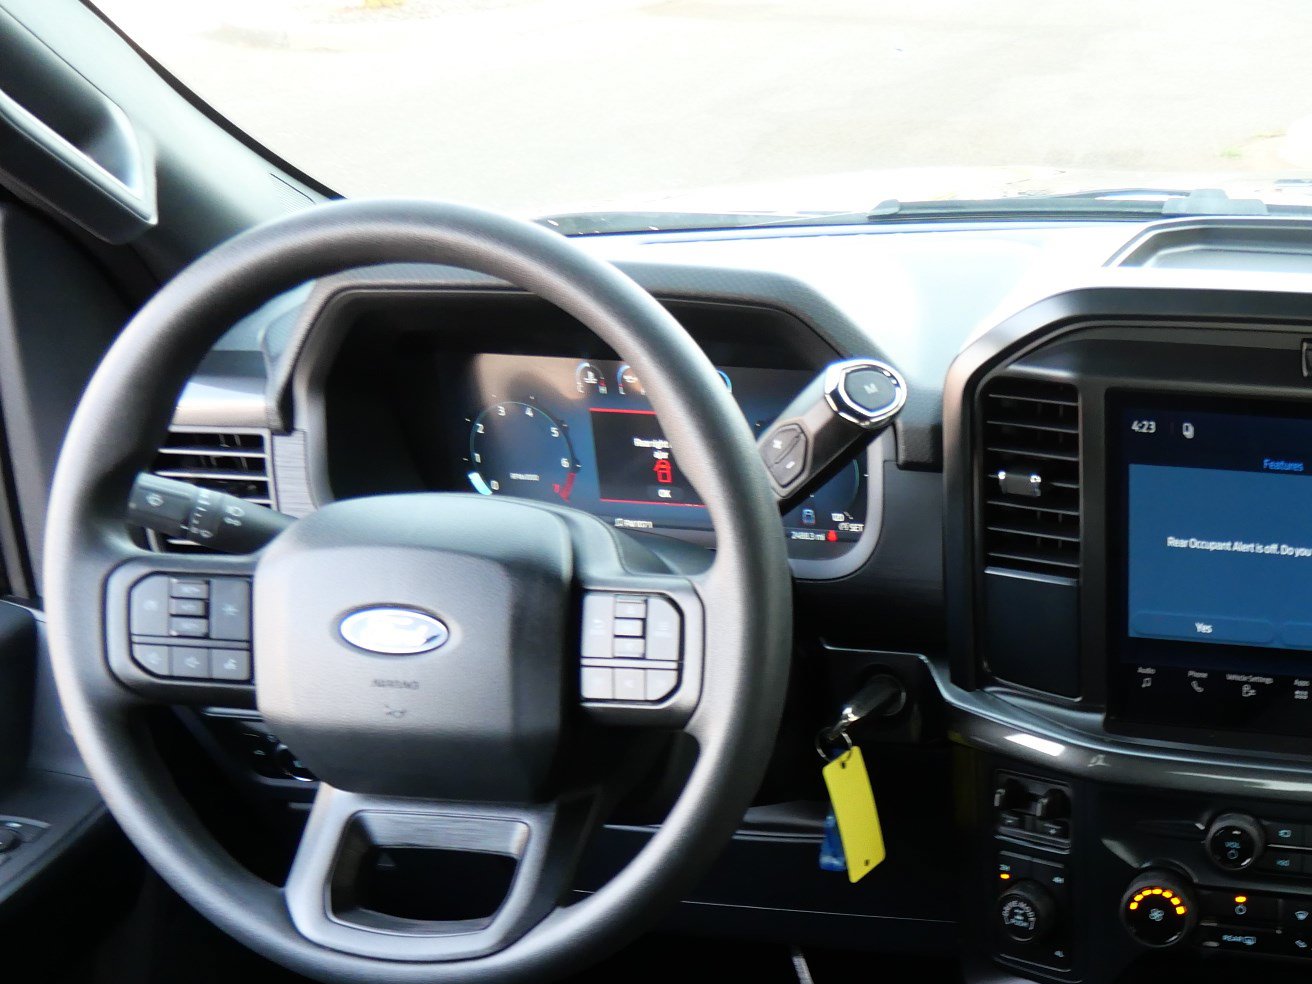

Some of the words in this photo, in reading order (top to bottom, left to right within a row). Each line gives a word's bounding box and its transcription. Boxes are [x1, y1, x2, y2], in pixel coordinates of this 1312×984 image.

[497, 405, 506, 417] 3
[524, 407, 534, 418] 4
[475, 422, 485, 434] 2
[550, 426, 560, 438] 5
[1131, 420, 1157, 434] 4:23
[560, 457, 570, 469] 6
[1262, 457, 1304, 472] Features
[1167, 536, 1189, 548] Rear
[1189, 537, 1232, 551] Occupant
[1232, 541, 1255, 553] Alert
[1255, 543, 1264, 553] is
[1264, 543, 1280, 554] off.
[1280, 544, 1295, 555] Do
[1295, 548, 1312, 557] you
[1195, 622, 1213, 634] Yes
